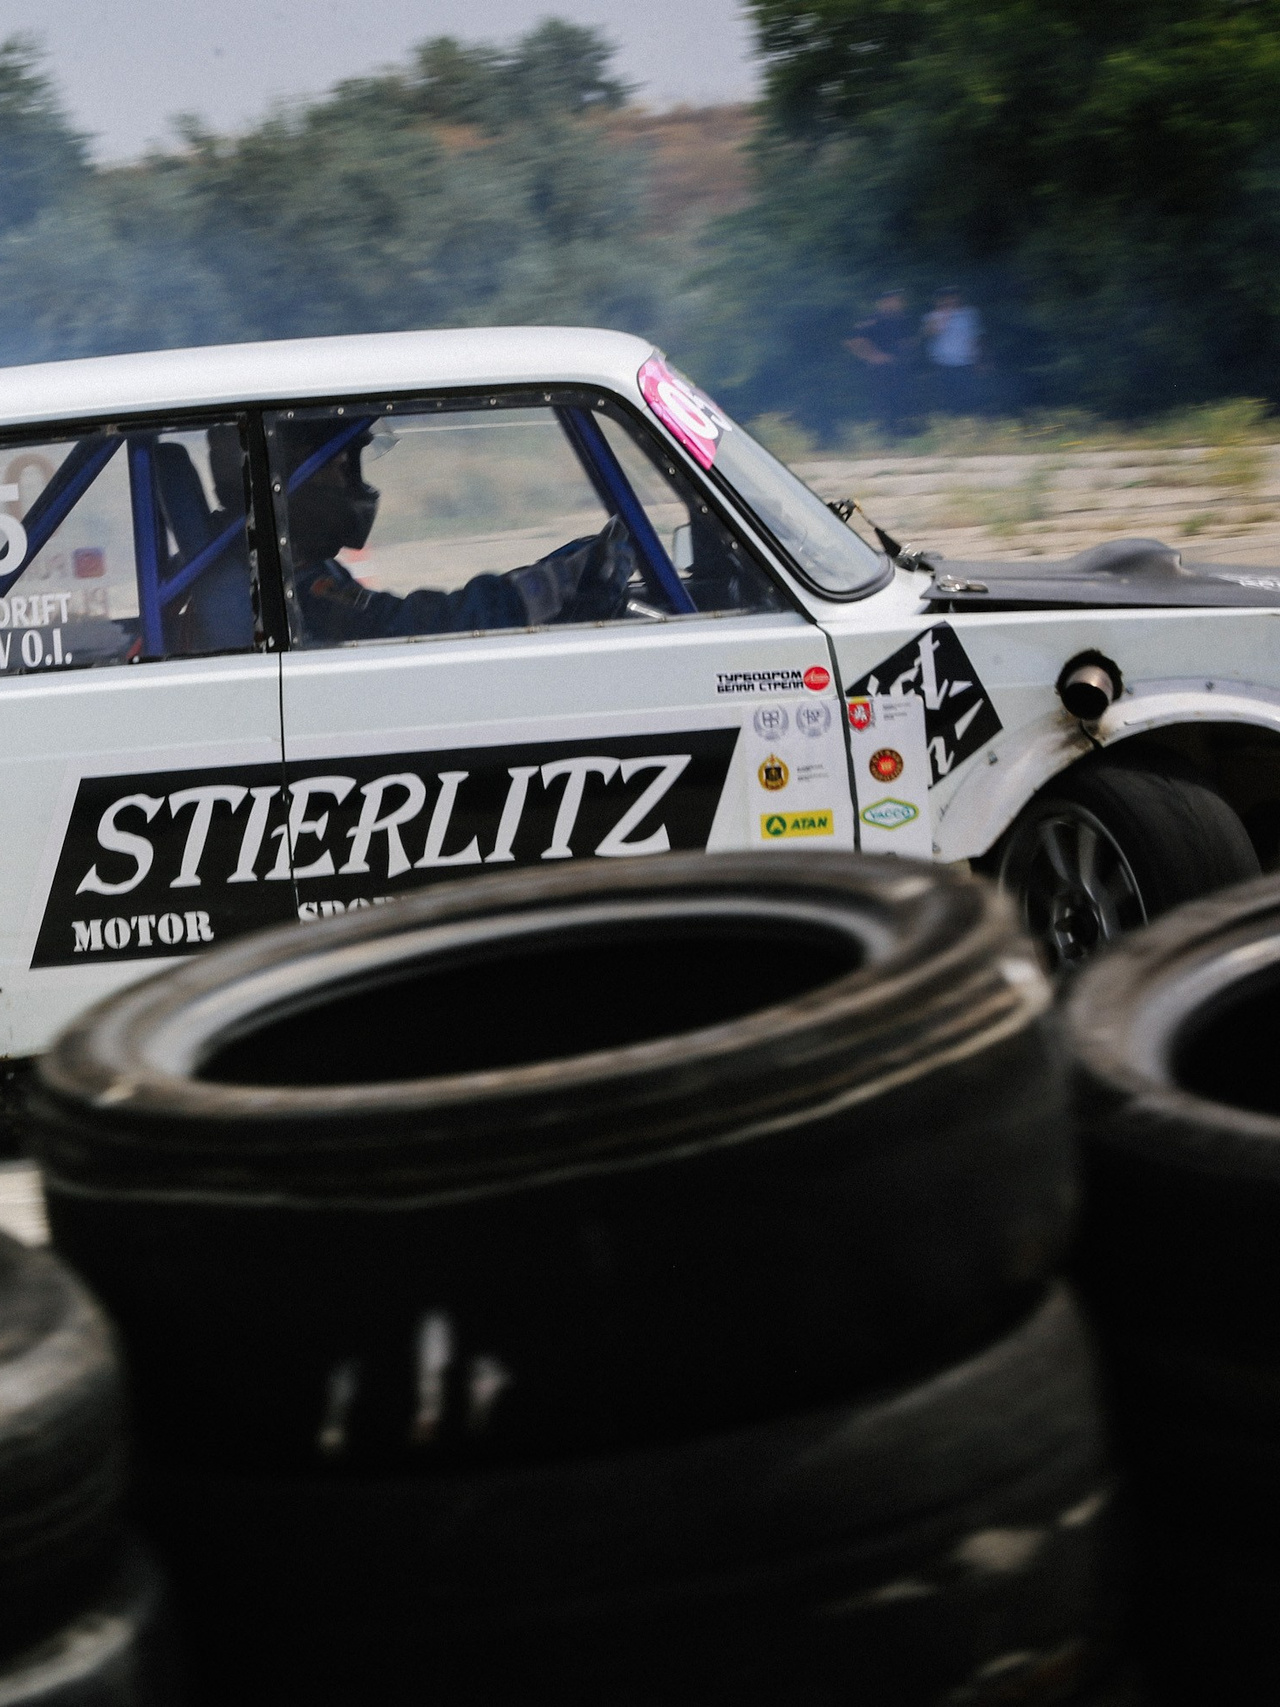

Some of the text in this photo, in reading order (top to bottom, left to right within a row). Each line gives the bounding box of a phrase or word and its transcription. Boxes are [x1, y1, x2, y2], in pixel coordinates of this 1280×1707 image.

[21, 628, 73, 668] O.I.
[717, 670, 803, 683] ТУРБОДРОМ
[74, 754, 693, 896] STIERLITZ
[791, 816, 828, 831] ATAN
[71, 911, 215, 954] MOTOR
